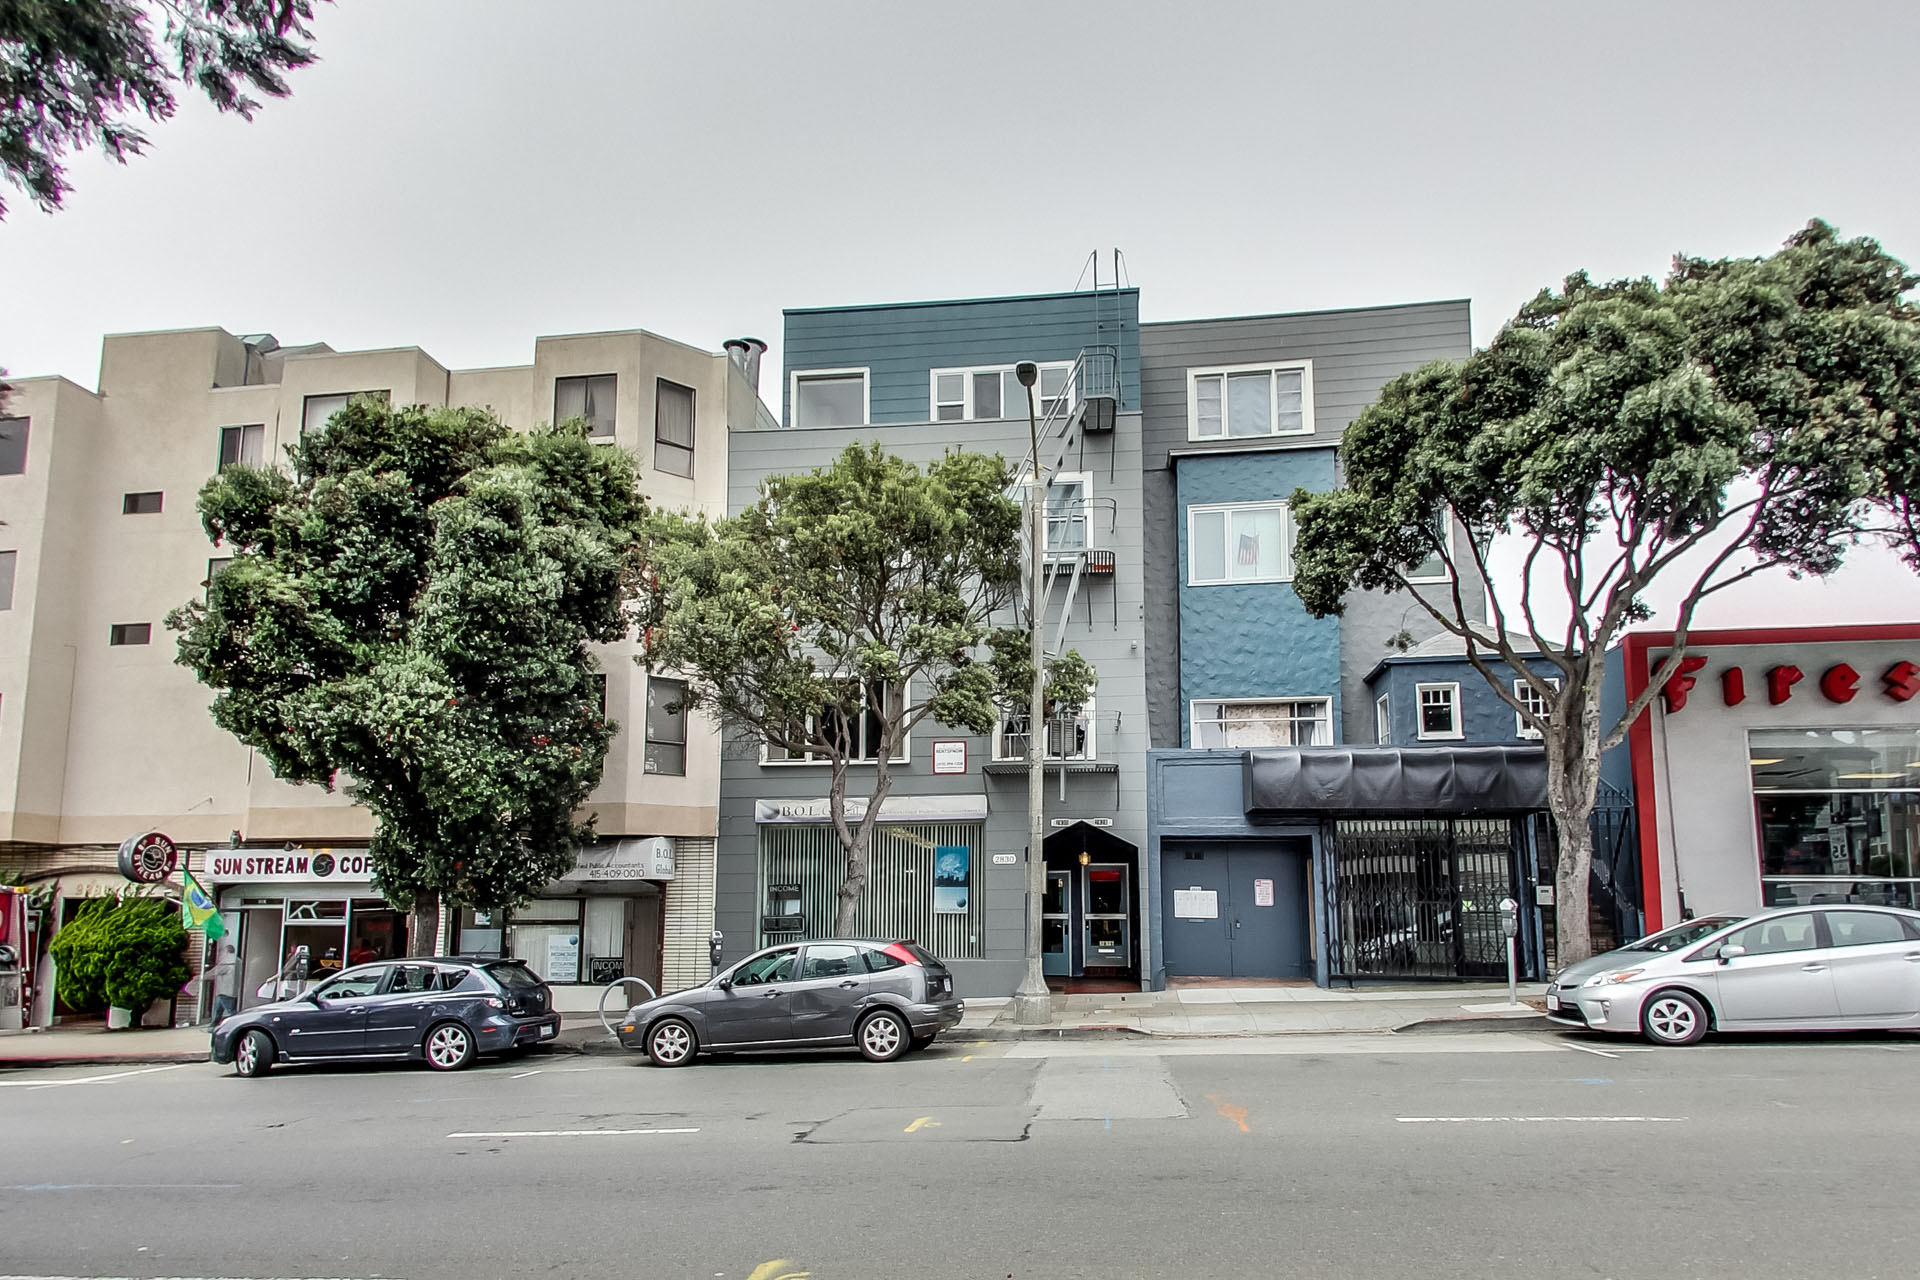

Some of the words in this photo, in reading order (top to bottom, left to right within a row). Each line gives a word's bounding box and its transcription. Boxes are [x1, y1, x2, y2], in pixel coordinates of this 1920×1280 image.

[155, 837, 173, 853] SUN
[133, 854, 163, 880] STREAM
[214, 858, 242, 875] SUN
[246, 857, 308, 875] STREAM
[340, 856, 377, 873] COF
[656, 864, 673, 875] Global
[589, 869, 645, 879] 415-409-0010
[593, 961, 624, 970] INCOM
